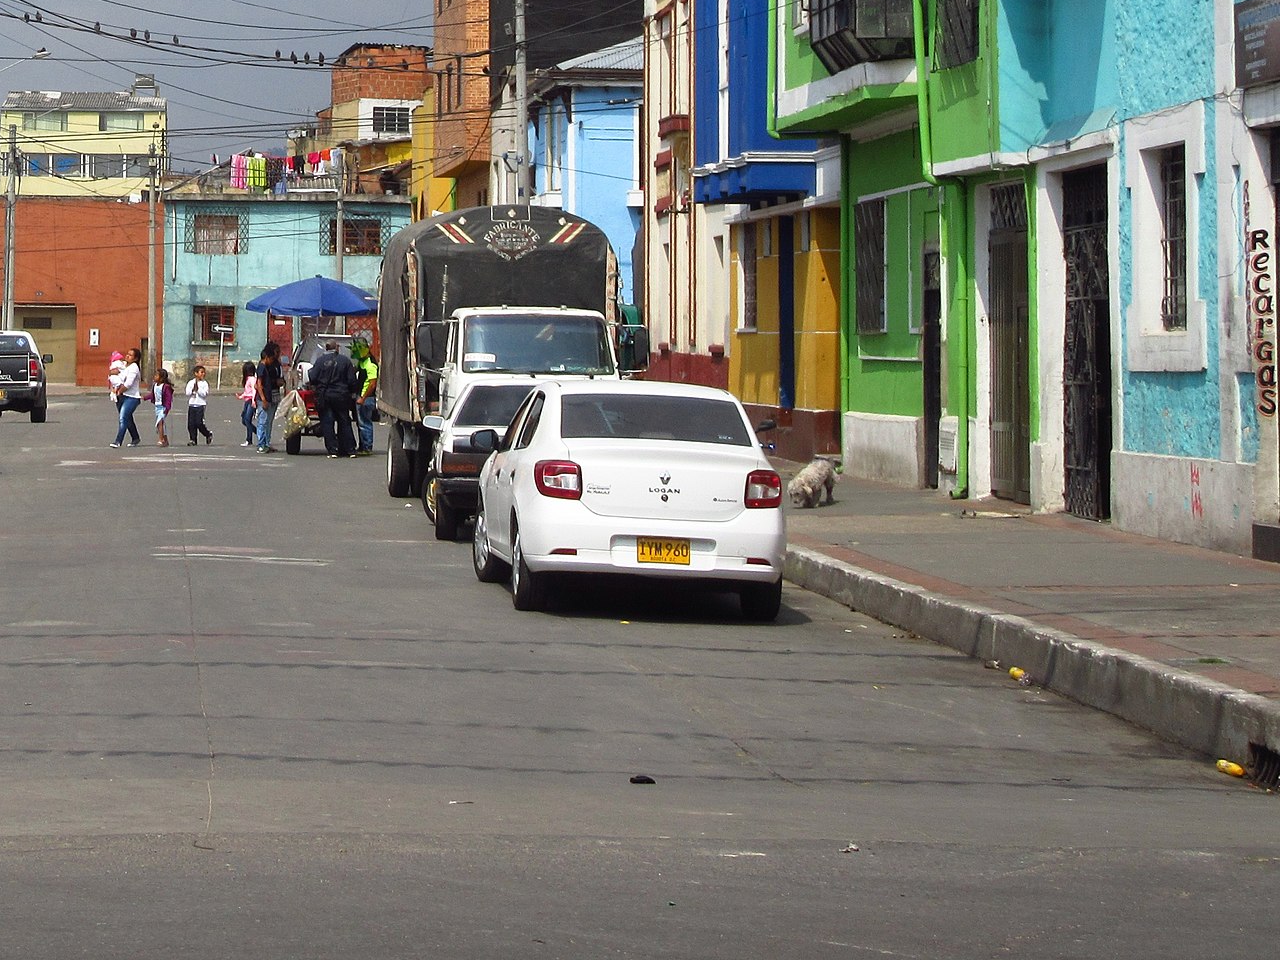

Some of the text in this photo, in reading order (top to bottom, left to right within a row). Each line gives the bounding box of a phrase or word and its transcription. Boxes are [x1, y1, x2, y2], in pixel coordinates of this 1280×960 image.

[483, 220, 541, 243] FABRICANTE
[639, 540, 689, 558] IYM 960
